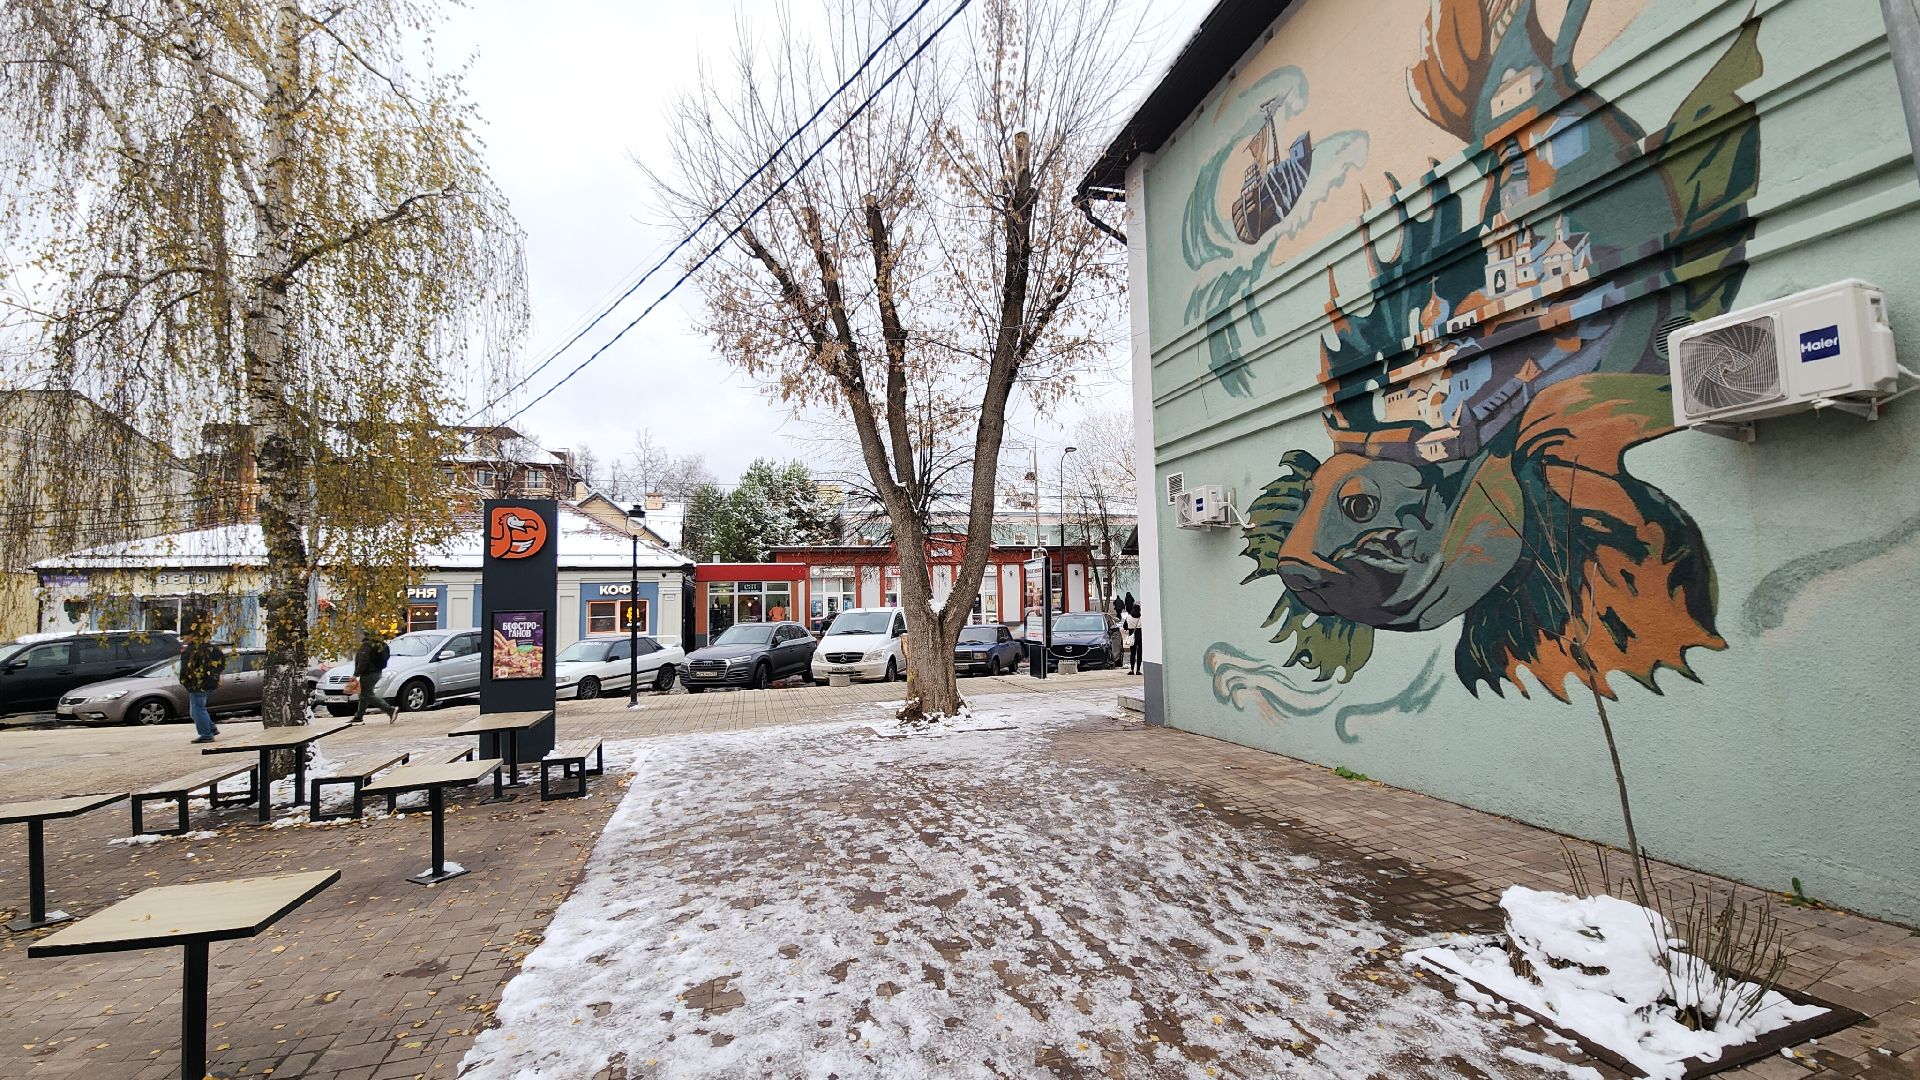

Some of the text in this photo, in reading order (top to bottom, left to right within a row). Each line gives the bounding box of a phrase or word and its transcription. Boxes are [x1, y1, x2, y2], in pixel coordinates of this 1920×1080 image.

[1800, 336, 1838, 353] Haier
[599, 584, 640, 595] КОФ
[508, 629, 532, 638] ГАНОВ
